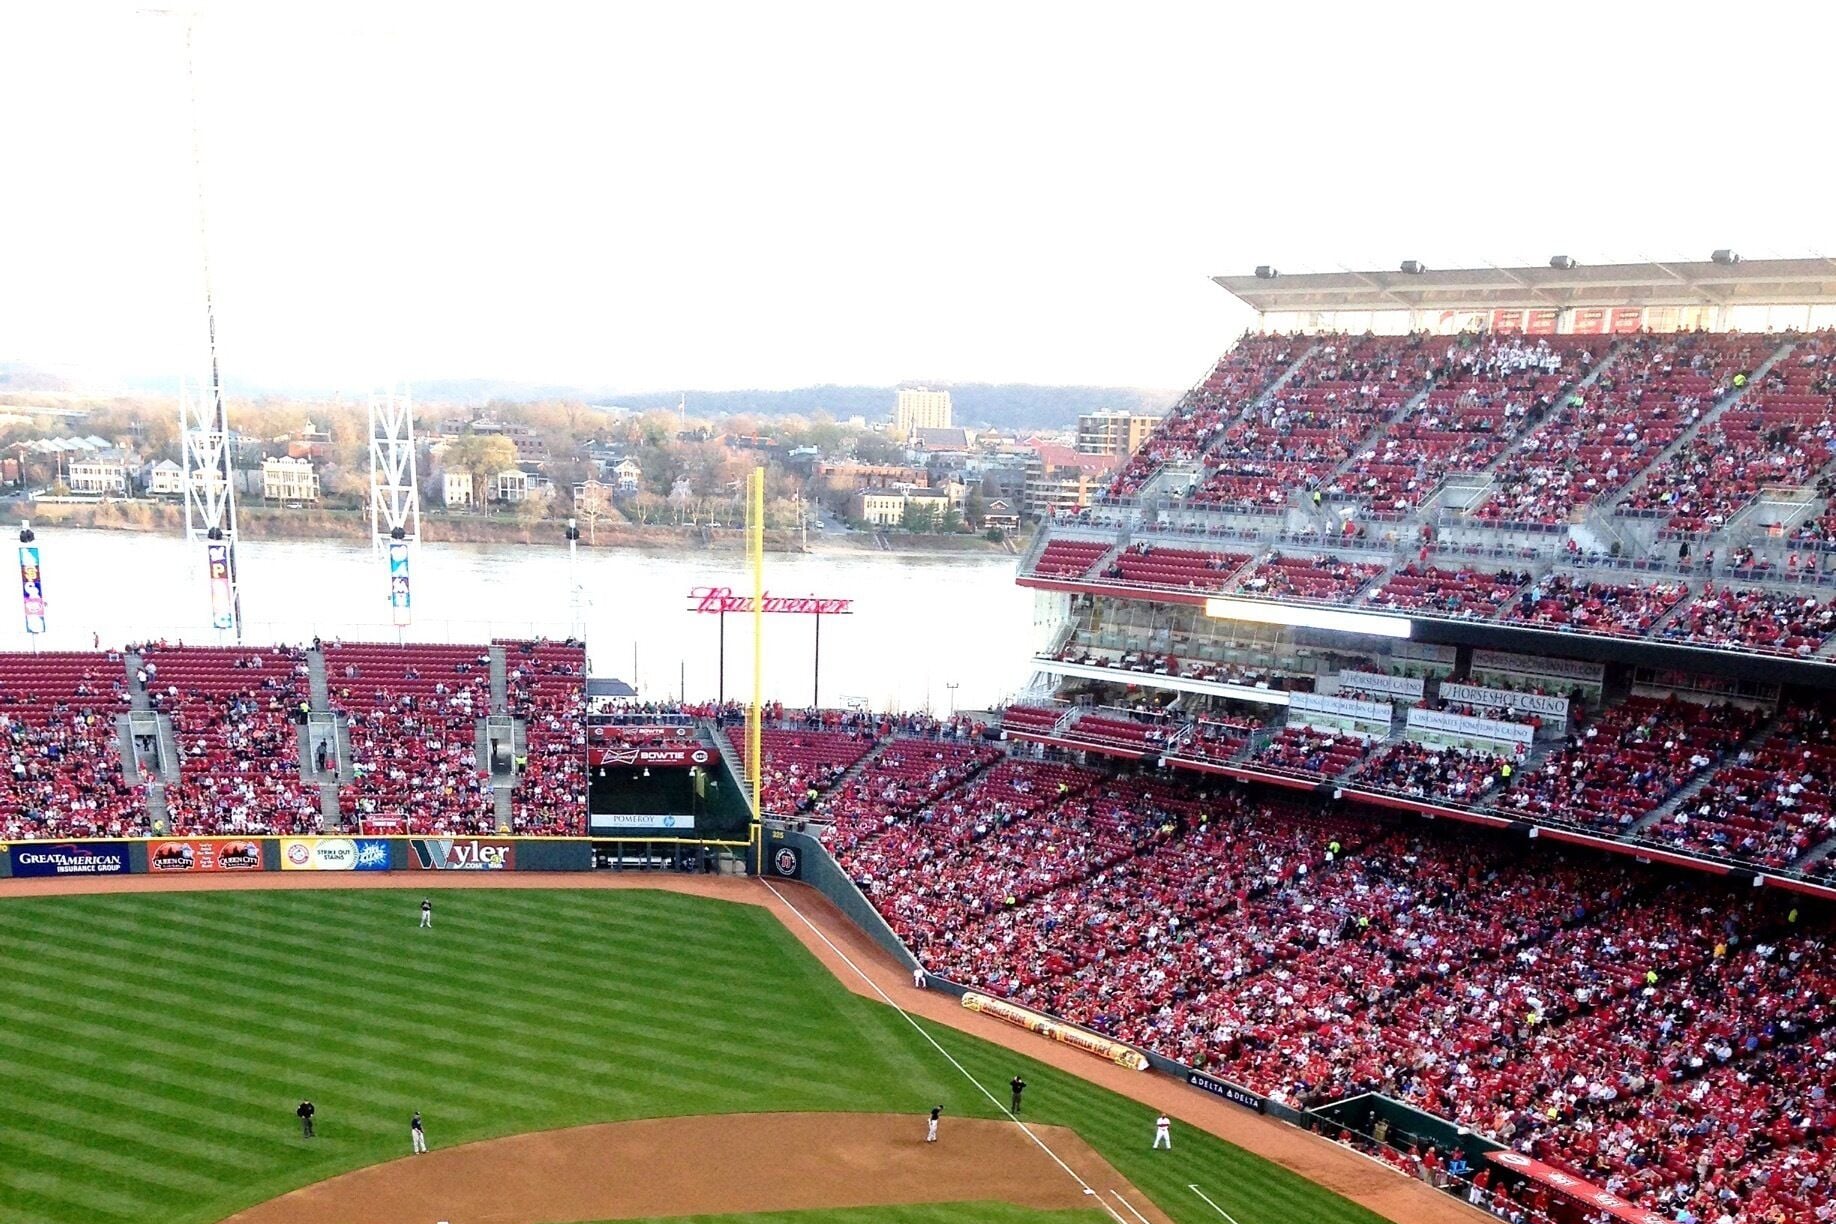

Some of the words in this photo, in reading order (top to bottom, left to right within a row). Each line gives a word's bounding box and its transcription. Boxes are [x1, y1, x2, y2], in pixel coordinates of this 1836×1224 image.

[1520, 696, 1565, 713] CASINO
[613, 815, 654, 823] POMEROY
[410, 838, 510, 870] Wyler
[56, 864, 95, 873] INSURANCE
[97, 864, 121, 872] GROUP
[1198, 1078, 1223, 1094] DELTA
[1233, 1092, 1259, 1108] DELTA
